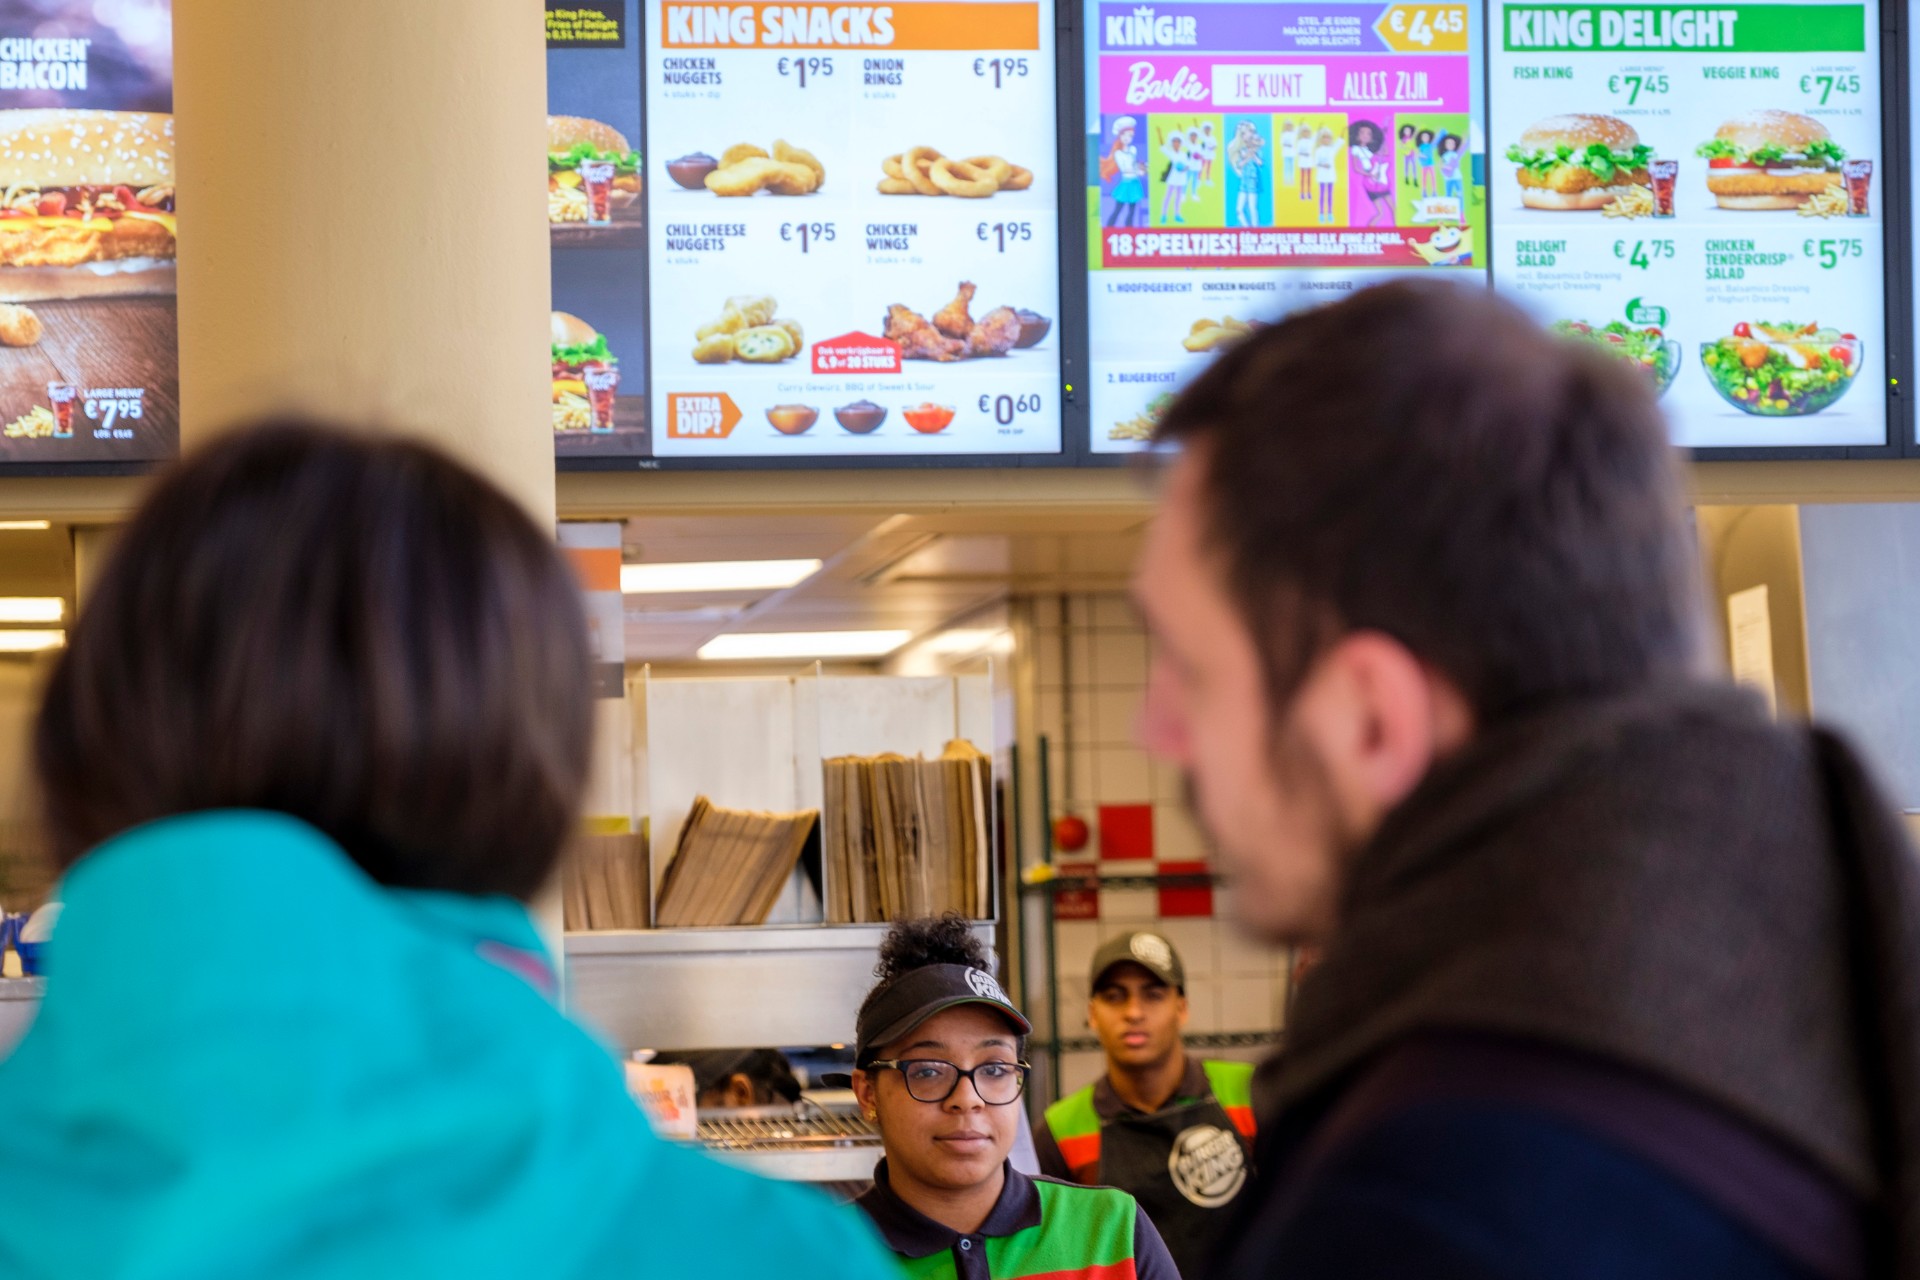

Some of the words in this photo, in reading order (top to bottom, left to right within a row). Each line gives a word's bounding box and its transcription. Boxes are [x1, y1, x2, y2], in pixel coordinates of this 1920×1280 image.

[667, 6, 756, 44] KING
[761, 6, 895, 45] SNACKS
[1298, 16, 1320, 26] STEL
[1321, 16, 1332, 26] JE
[1334, 16, 1361, 26] EIGEN
[1105, 15, 1174, 46] KING
[1174, 15, 1197, 36] JR
[1283, 26, 1328, 36] MAALTIJD
[1328, 26, 1361, 36] SAMEN
[1510, 9, 1593, 47] KING
[1600, 9, 1738, 47] DELIGHT
[1295, 36, 1320, 46] VOOR
[1321, 36, 1361, 46] SLECHTS
[663, 57, 716, 70] CHICKEN
[864, 58, 904, 71] ONION
[0, 61, 88, 90] BACON
[663, 72, 722, 85] NUGGETS
[1514, 66, 1539, 79] FISH
[1543, 66, 1573, 79] KING
[1703, 66, 1746, 79] VEGGIE
[1750, 66, 1780, 79] KING
[864, 73, 903, 86] RINGS
[1126, 61, 1210, 106] Barbie
[1235, 73, 1252, 98] JE
[1257, 73, 1303, 98] KUNT
[1343, 70, 1388, 100] ALLES
[1394, 70, 1429, 100] ZIJN
[666, 223, 698, 237] CHILI
[702, 223, 746, 237] CHEESE
[866, 224, 918, 236] CHICKEN
[666, 238, 725, 251] NUGGETS
[866, 238, 909, 250] WINGS
[1107, 233, 1133, 257] 18
[1135, 232, 1238, 257] SPEELTJES!
[1516, 240, 1567, 253] DELIGHT
[1705, 239, 1755, 252] CHICKEN
[1516, 254, 1556, 267] SALAD
[1516, 271, 1533, 280] incl.
[1537, 271, 1581, 280] Balsamico
[1584, 271, 1622, 282] Dressing
[1705, 267, 1745, 280] SALAD
[1117, 282, 1192, 293] HOOFDGERECHT
[1202, 282, 1236, 291] CHICKEN
[1238, 282, 1276, 291] NUGGETS
[1300, 282, 1353, 291] HAMBURGER
[1516, 282, 1526, 290] of
[1528, 282, 1561, 292] Yoghurt
[1563, 282, 1601, 292] Dressing
[1726, 284, 1770, 293] Balsamico
[1772, 284, 1810, 294] Dressing
[1717, 295, 1750, 304] Yoghurt
[1752, 295, 1790, 304] Dressing
[1118, 372, 1176, 383] BIJGERECHT
[777, 383, 802, 393] Curry
[845, 383, 864, 391] BBQ
[867, 383, 875, 391] of
[880, 383, 905, 391] Sweet
[916, 383, 935, 391] Sour
[676, 397, 722, 412] EXTRA
[676, 411, 722, 434] DIP?
